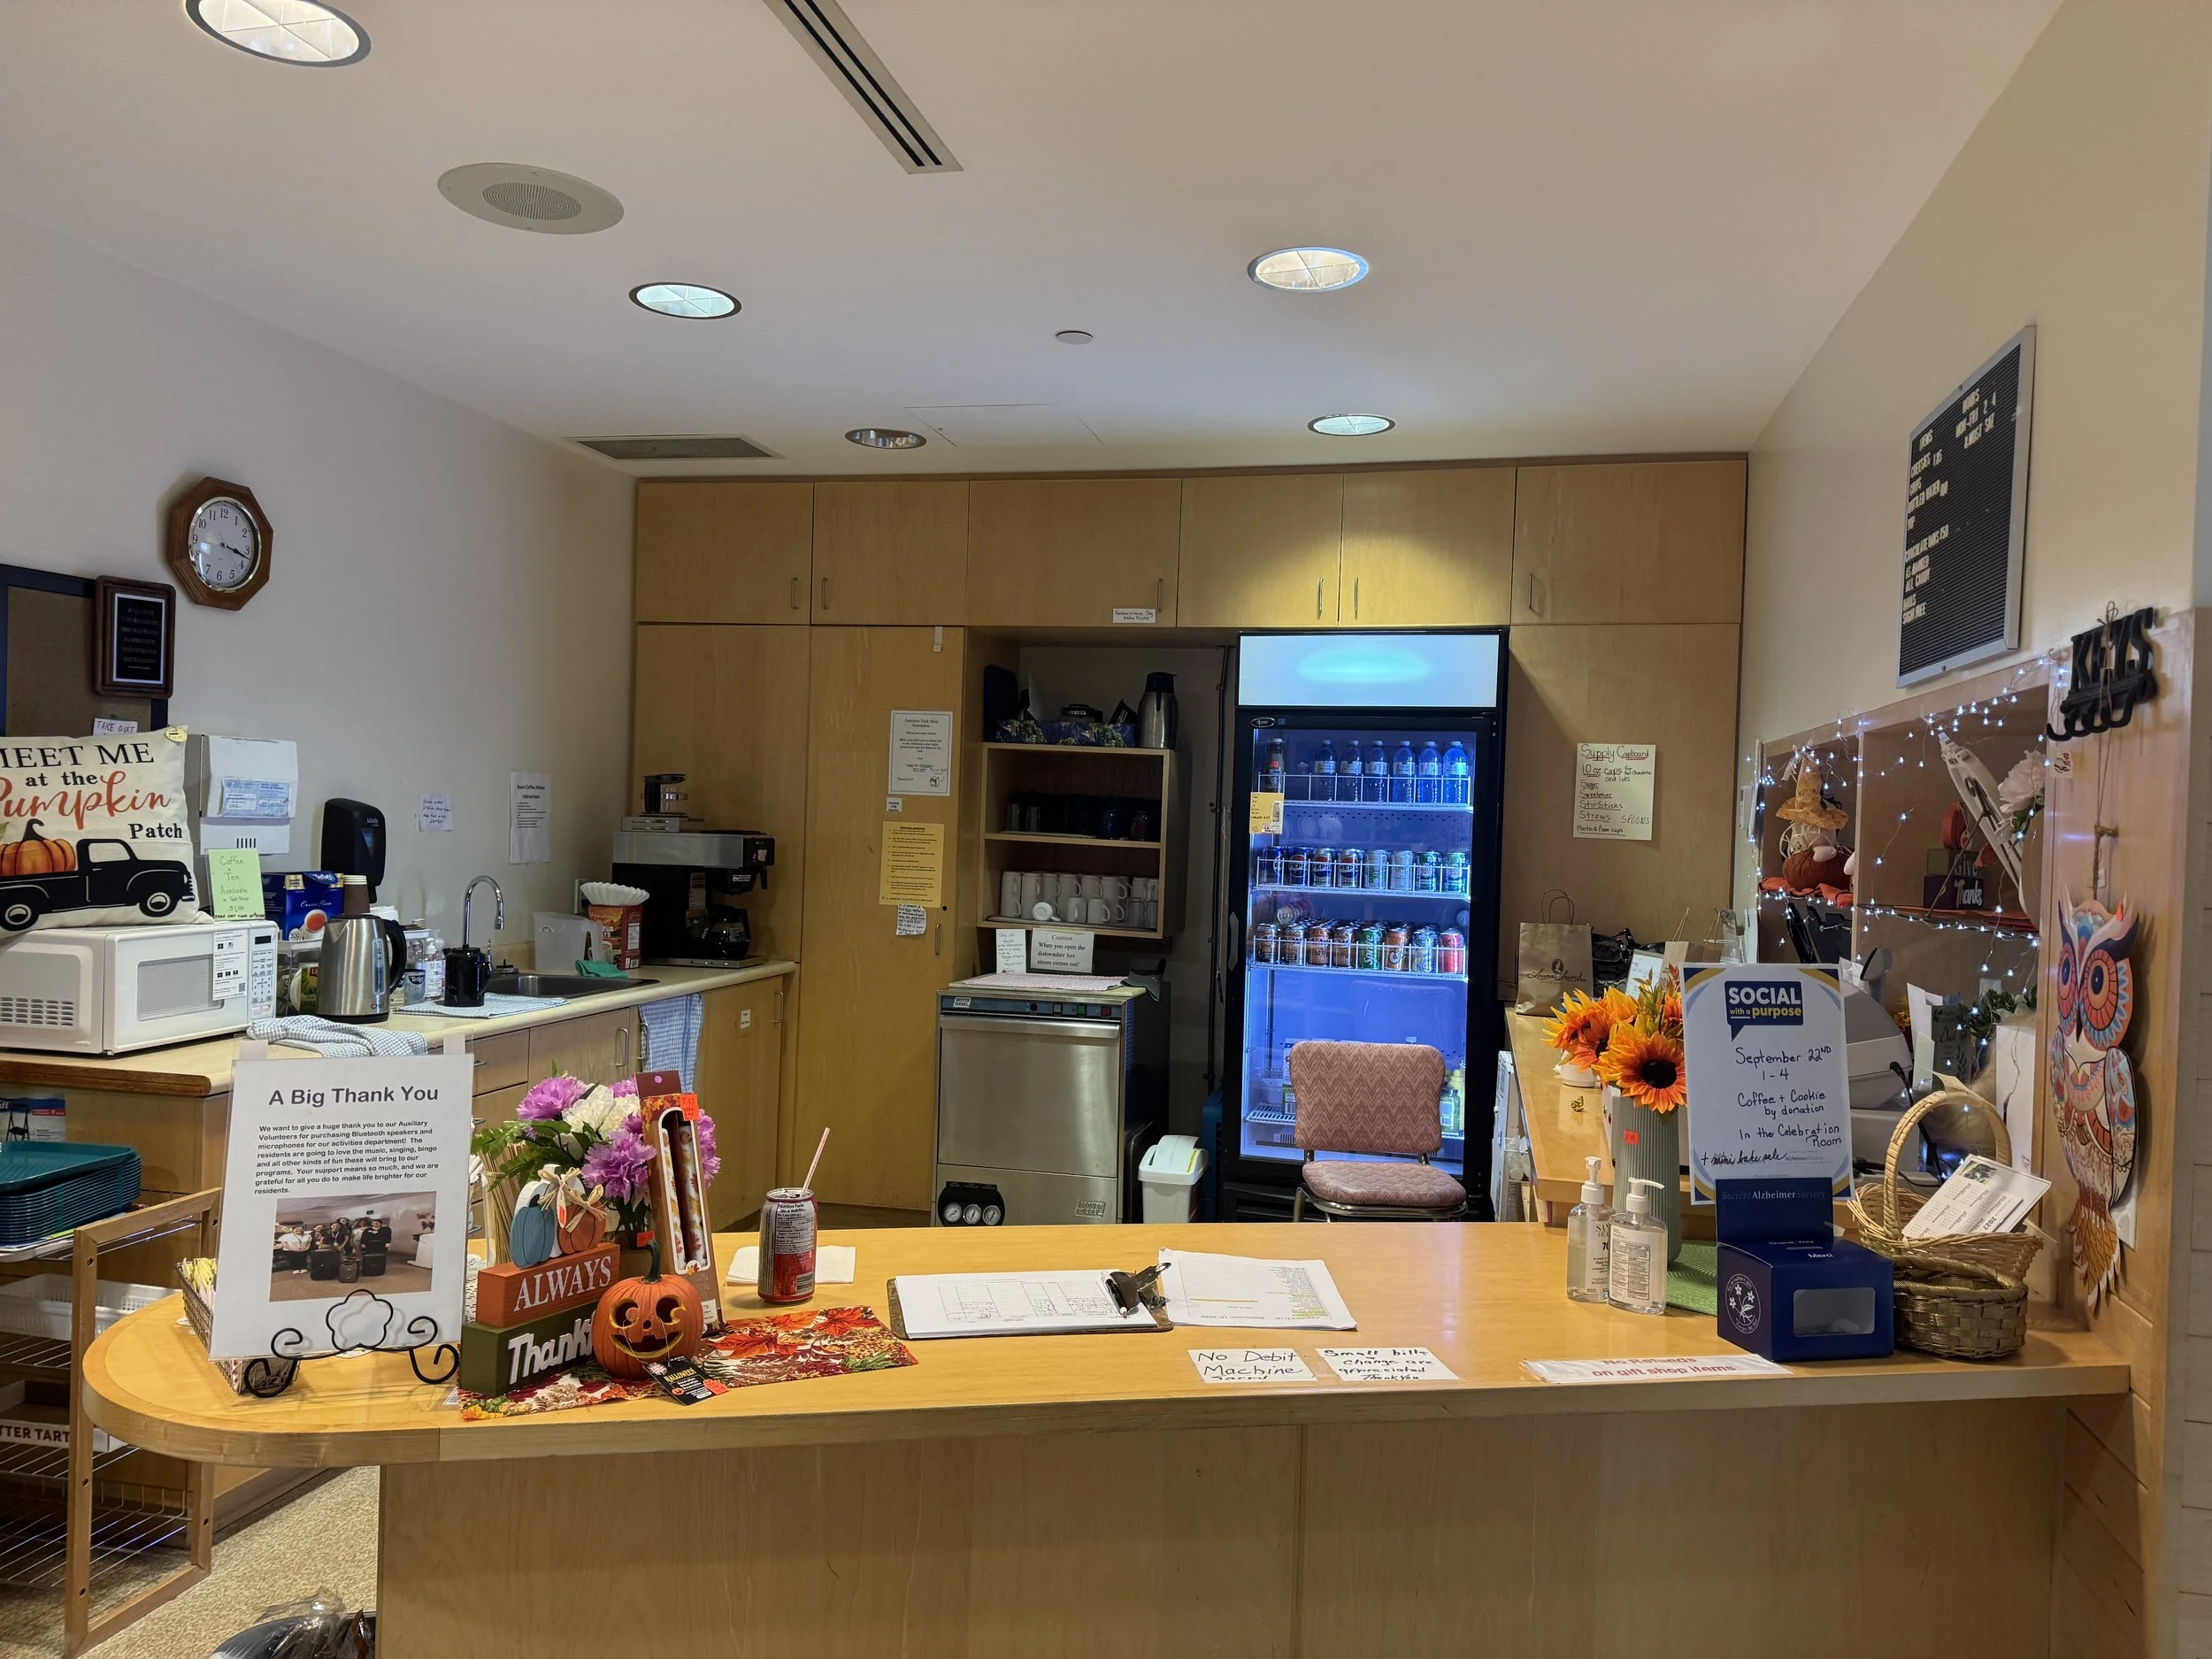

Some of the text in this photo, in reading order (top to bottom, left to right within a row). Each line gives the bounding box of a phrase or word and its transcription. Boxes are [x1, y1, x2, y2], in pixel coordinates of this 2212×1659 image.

[209, 510, 216, 520] 11
[220, 508, 228, 518] 12
[198, 518, 206, 529] 10
[234, 516, 238, 525] 1
[192, 534, 198, 544] 9
[242, 528, 248, 538] 2
[195, 550, 200, 559] 8
[245, 546, 250, 555] 3
[205, 565, 211, 574] 7
[217, 571, 222, 580] 6
[229, 570, 235, 579] 5
[96, 720, 114, 732] TAKE
[95, 743, 154, 764] ME
[1581, 744, 1649, 763] Supply Cupboard
[1582, 764, 1592, 773] 10
[1603, 767, 1623, 777] cups
[25, 772, 97, 787] at the
[1578, 810, 1611, 820] Straws
[128, 823, 182, 839] Patch
[219, 856, 244, 865] Coffee
[1954, 854, 1978, 876] Give
[224, 872, 240, 881] Tea
[1954, 879, 1983, 908] Thanks
[1728, 987, 1801, 1005] SOCIAL
[1752, 1006, 1801, 1018] purpose
[1735, 1047, 1801, 1070] September
[1779, 1068, 1789, 1080] 4
[268, 1086, 438, 1107] A Big Thank You
[1738, 1089, 1826, 1108] Coffee + Cookie
[1763, 1103, 1824, 1119] by donation
[1740, 1123, 1839, 1140] In the Celebration
[1806, 1135, 1841, 1148] Room
[1701, 1151, 1709, 1165] +
[1752, 1190, 1796, 1200] Alzheimer
[513, 1256, 611, 1312] ALWAYS
[1198, 1350, 1297, 1362] No Debit
[664, 1367, 696, 1383] HALLOWEEN
[1204, 1365, 1303, 1376] Machine
[1617, 1368, 1645, 1377] gift
[1649, 1366, 1686, 1375] shop
